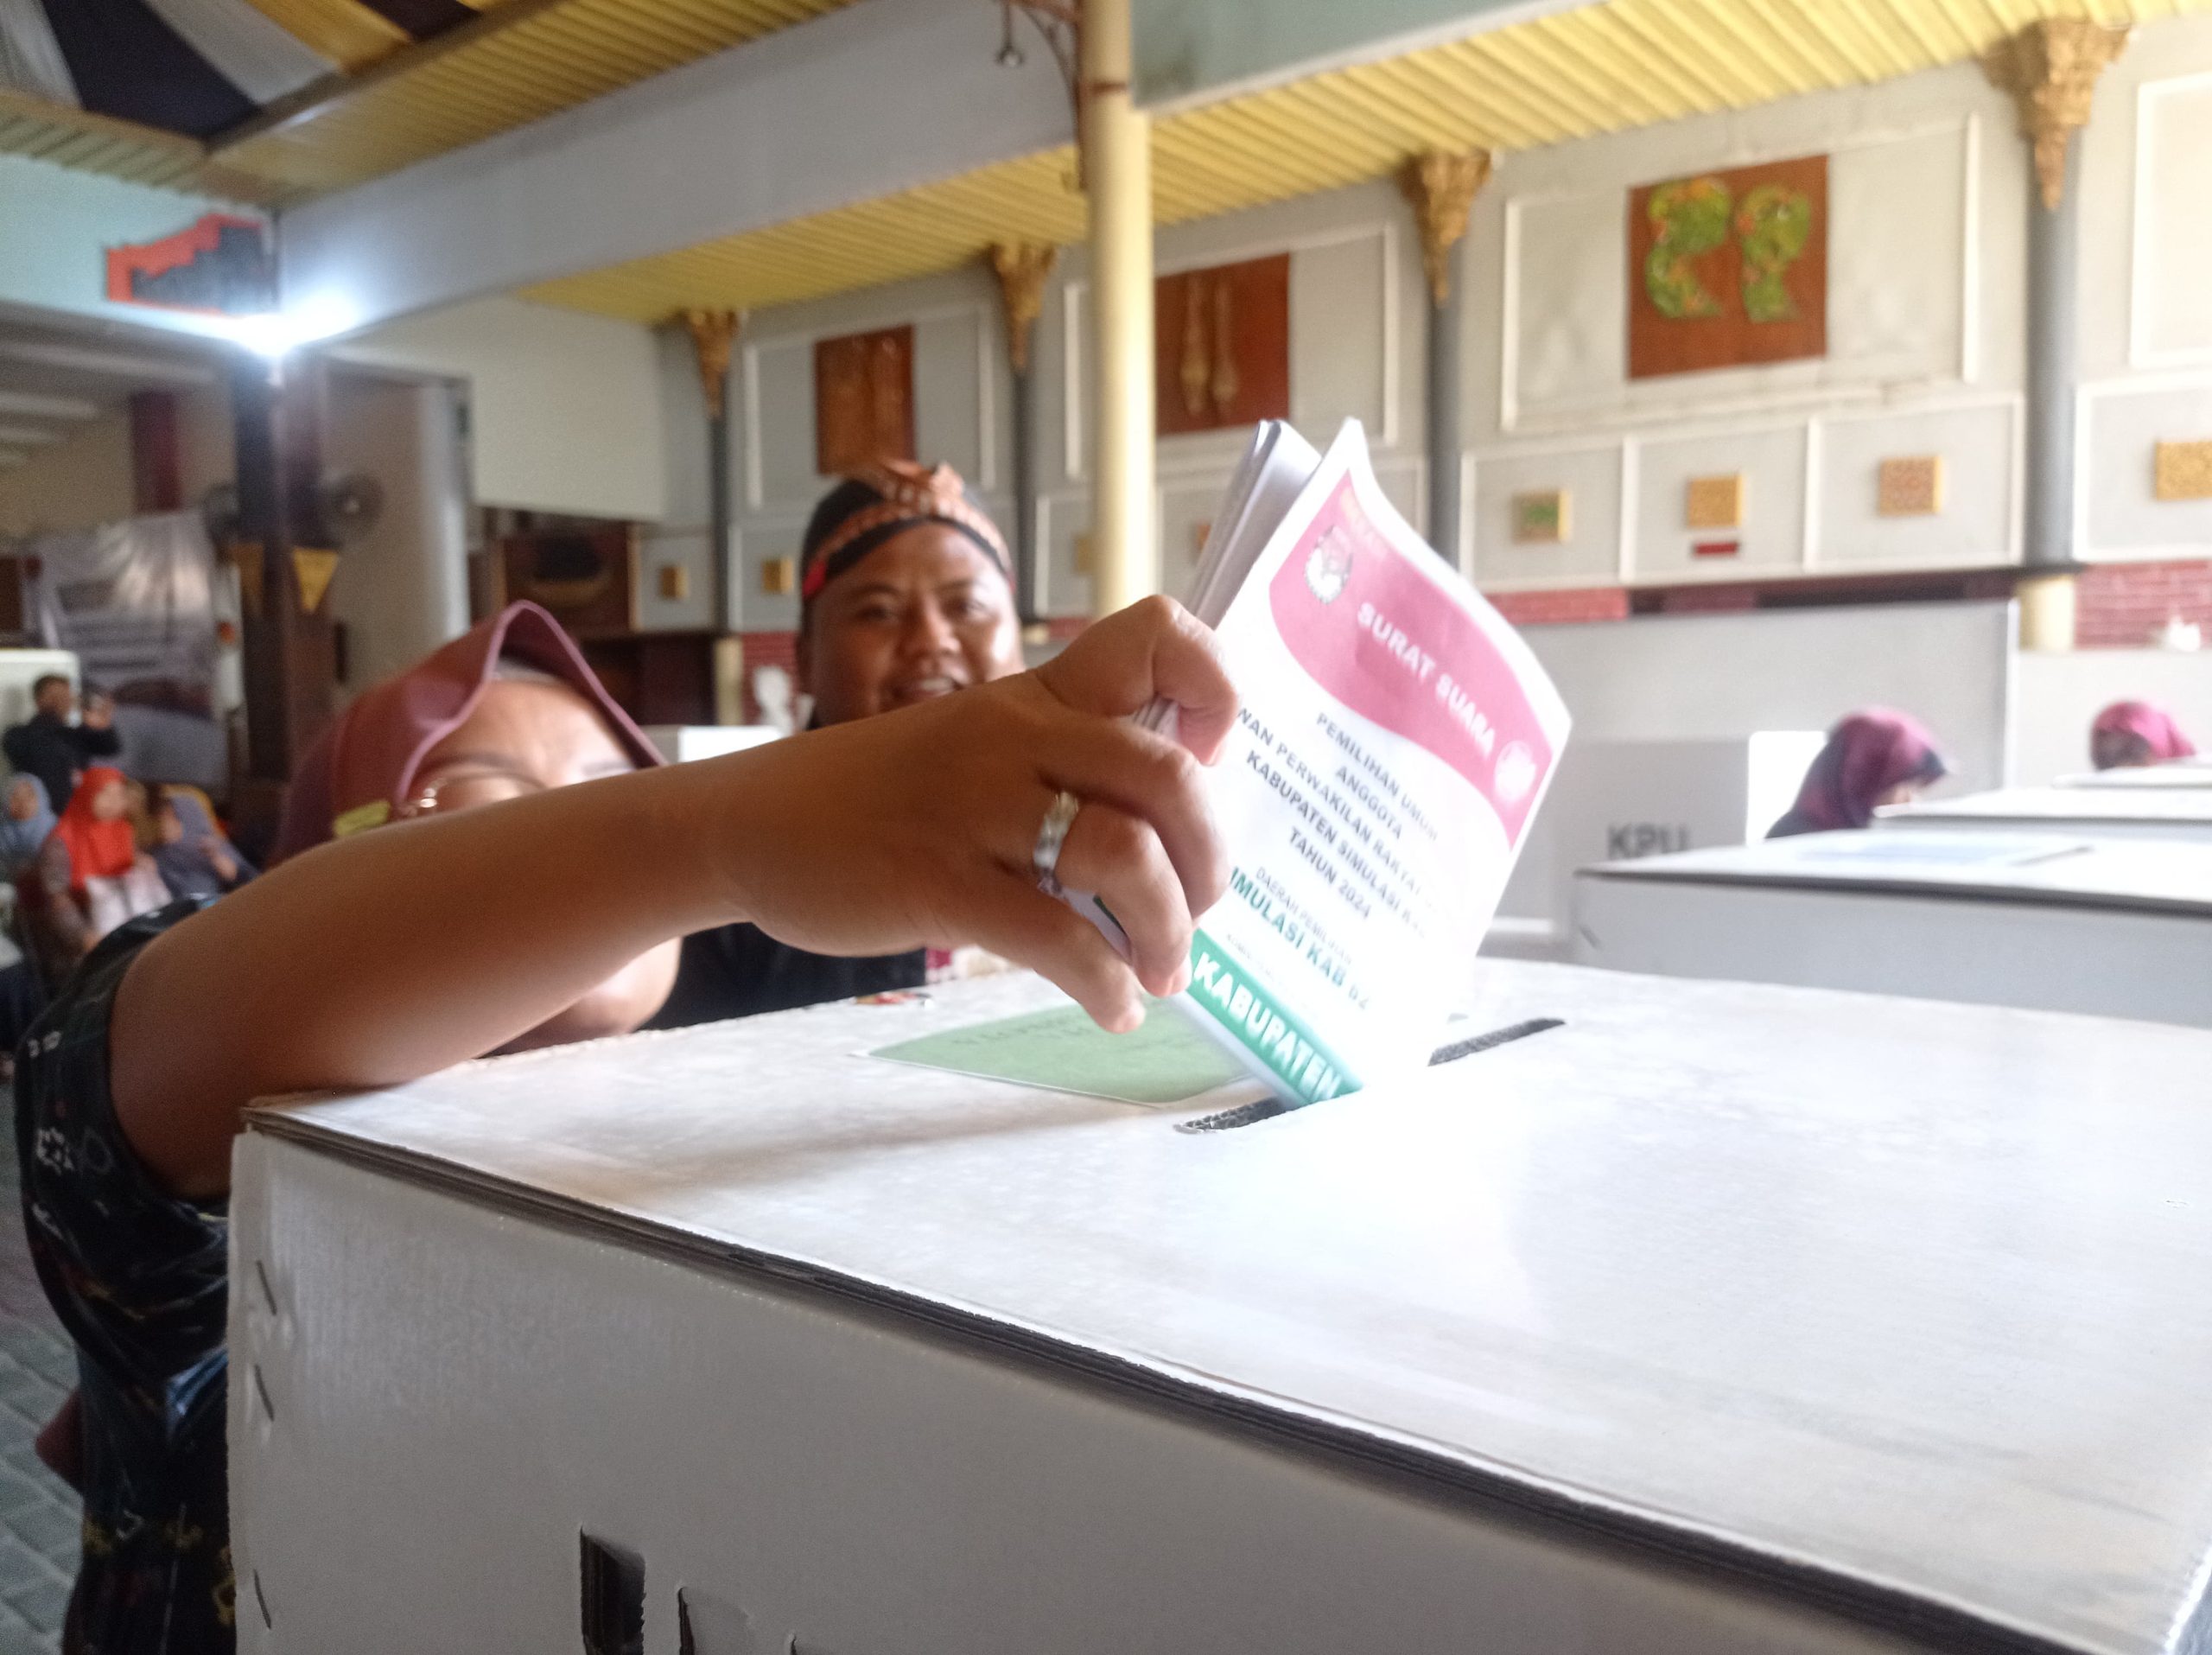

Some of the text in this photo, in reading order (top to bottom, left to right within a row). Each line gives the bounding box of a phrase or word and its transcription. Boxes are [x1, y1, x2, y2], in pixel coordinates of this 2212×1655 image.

[1357, 602, 1494, 759] SURAT SUARA
[1276, 742, 1372, 843] PERWAKILAN
[1316, 712, 1400, 797] PEMILIHAN
[1247, 749, 1338, 843] KABUPATEN
[1338, 839, 1402, 911] SIMULASI
[1335, 765, 1403, 839] ANGGOTA
[1607, 823, 1688, 860] KPU
[1256, 866, 1300, 914] DAERAH
[1289, 825, 1373, 920] TAHUN 2024
[1306, 940, 1346, 987] KAB
[1193, 953, 1340, 1099] KABUPATEN
